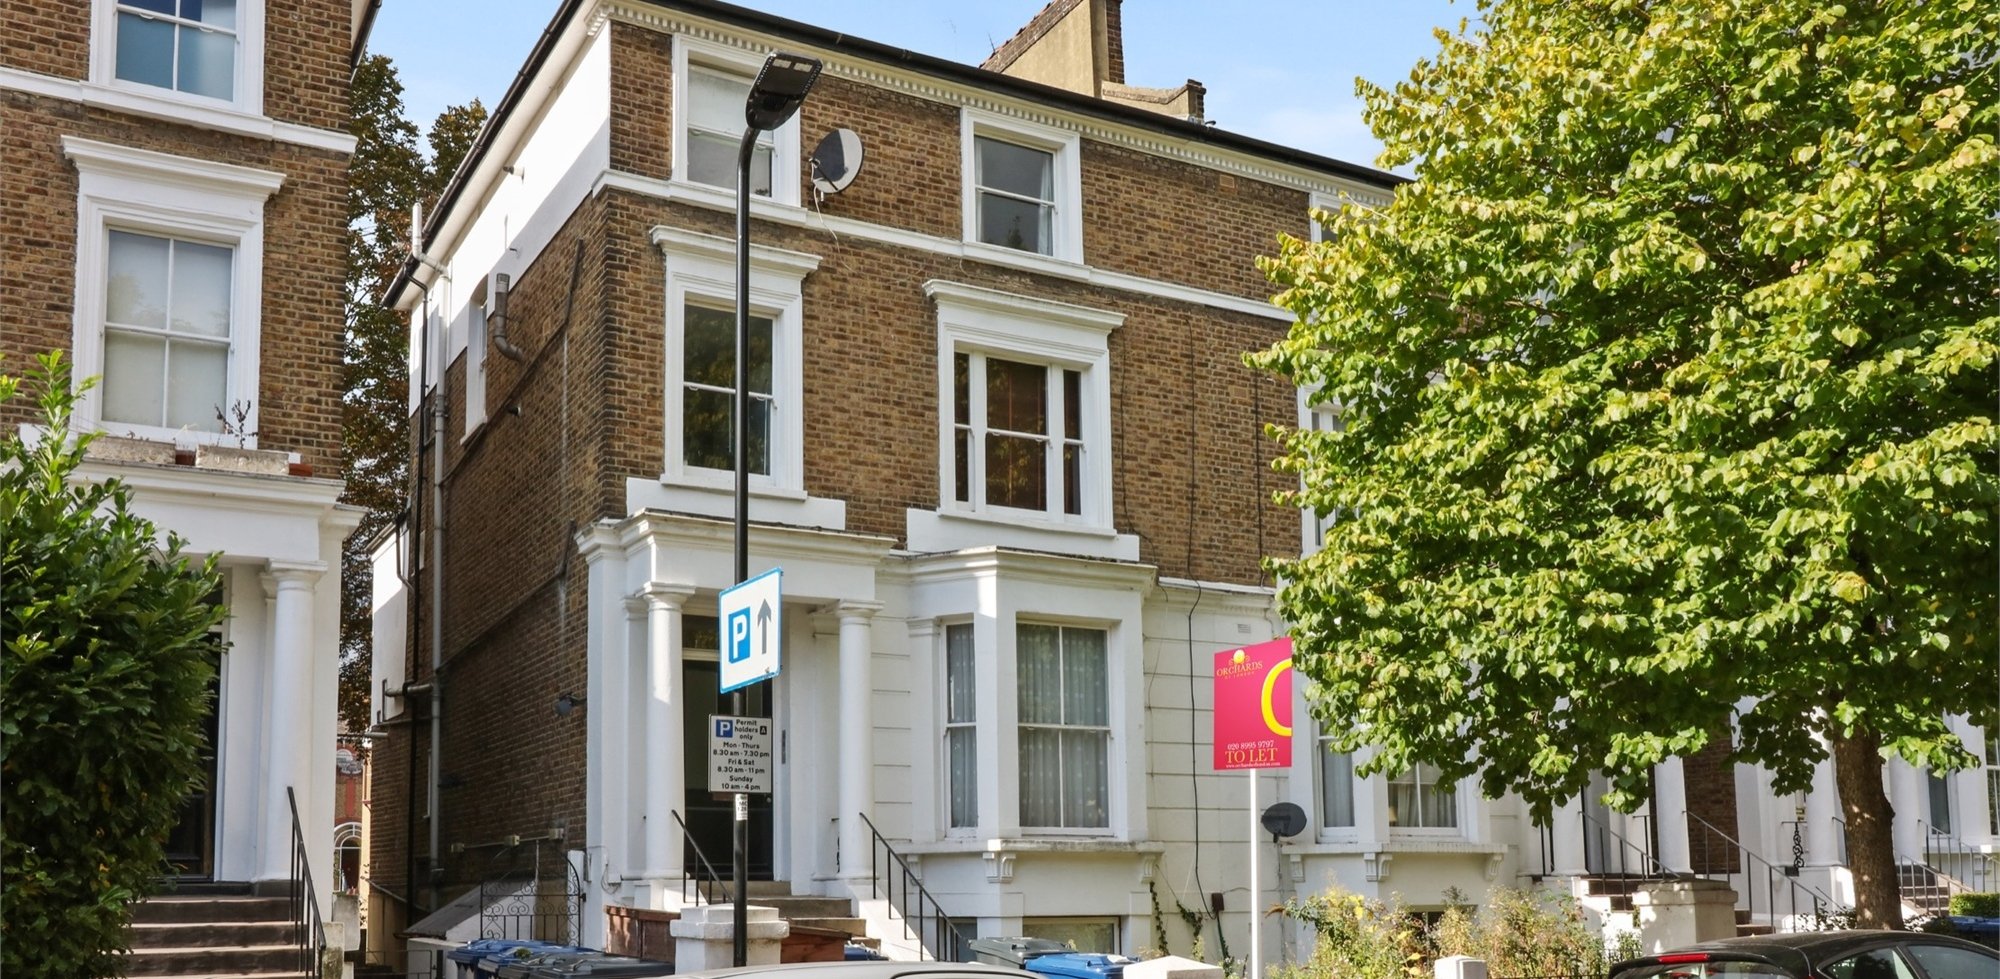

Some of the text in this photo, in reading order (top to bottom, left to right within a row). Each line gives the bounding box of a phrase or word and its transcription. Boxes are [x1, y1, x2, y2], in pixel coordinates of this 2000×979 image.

[733, 614, 748, 659] P
[1216, 662, 1263, 677] ORCHARDS
[720, 722, 730, 736] P
[1241, 741, 1256, 750] 8995
[1258, 740, 1274, 748] 9797
[1225, 748, 1278, 763] TO LET
